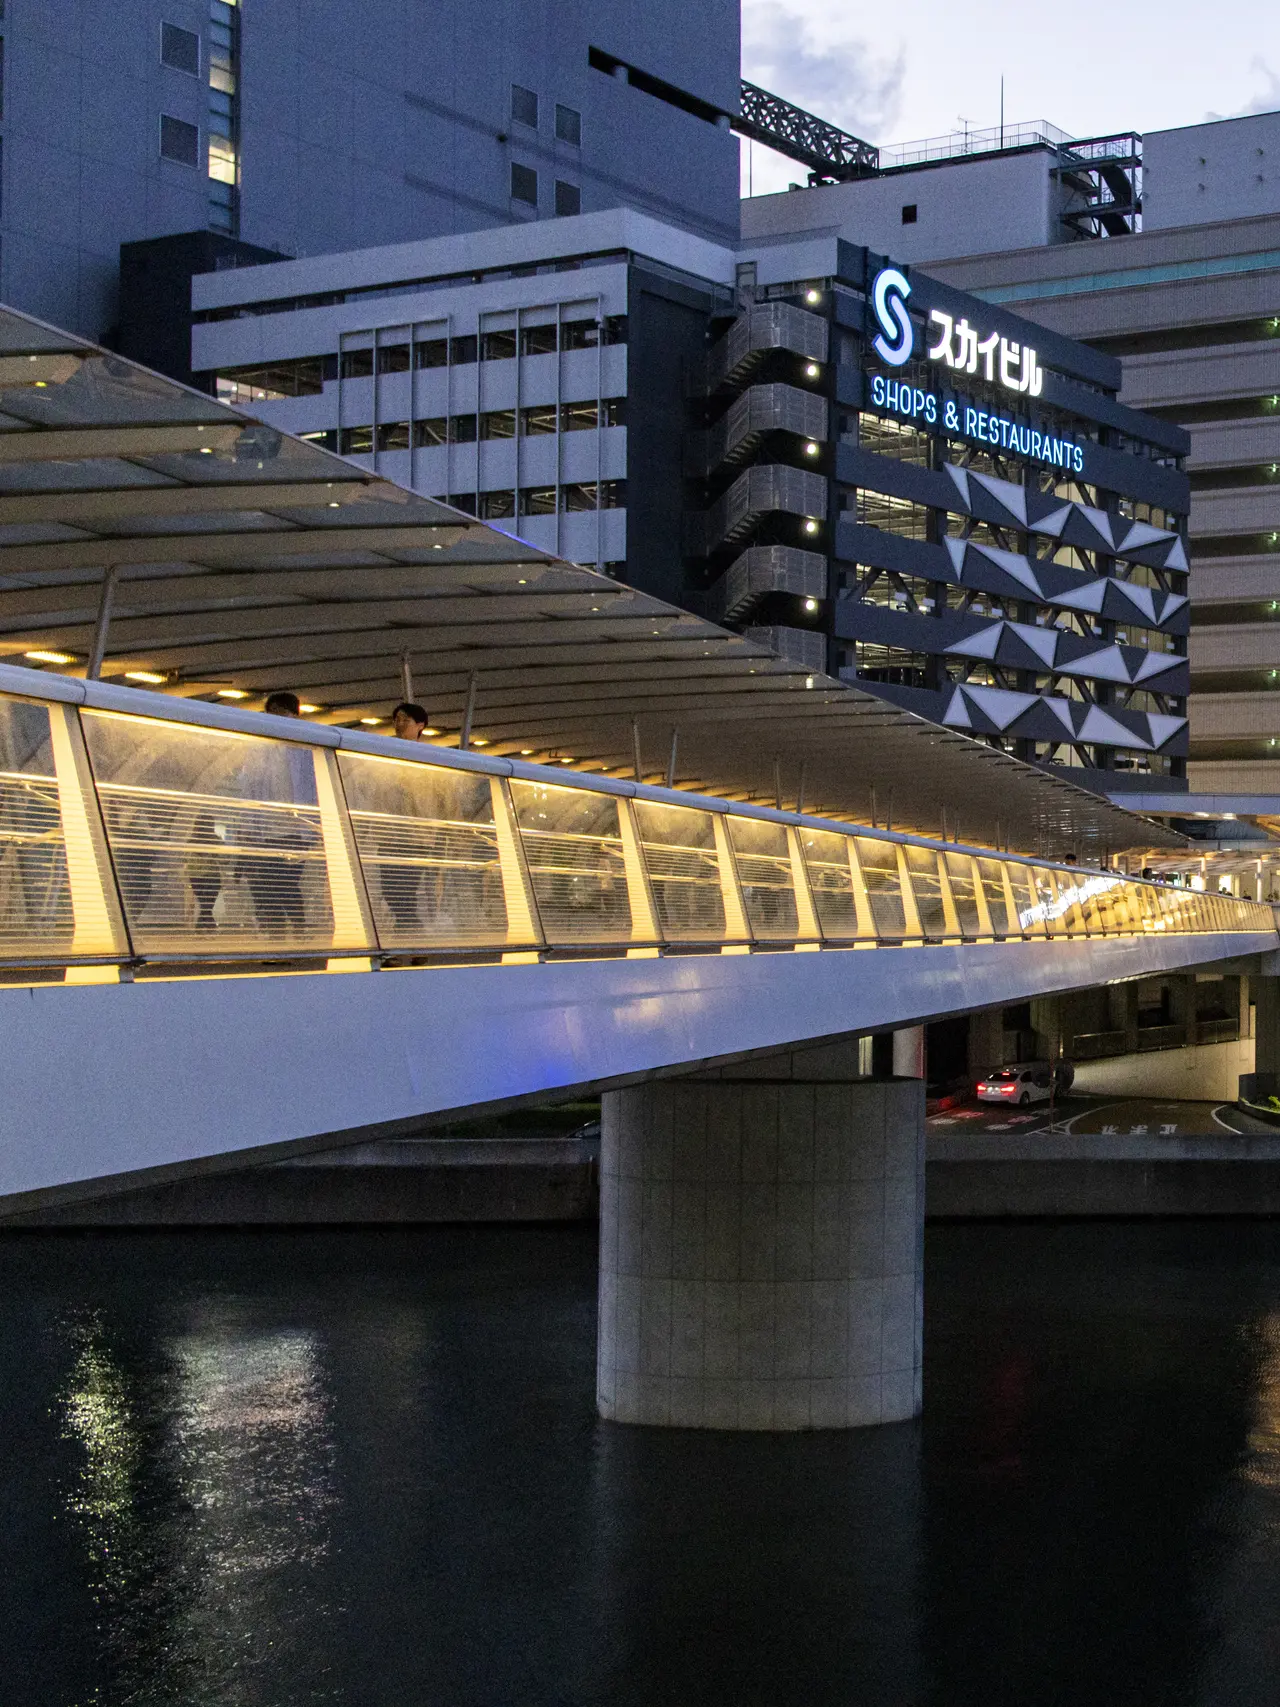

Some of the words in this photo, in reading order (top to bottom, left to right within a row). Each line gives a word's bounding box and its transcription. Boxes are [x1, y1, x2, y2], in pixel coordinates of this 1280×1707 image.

[929, 309, 1043, 397] スカイビル
[871, 375, 937, 424] SHOPS
[944, 400, 960, 431] &
[964, 407, 1084, 473] RESTAURANTS
